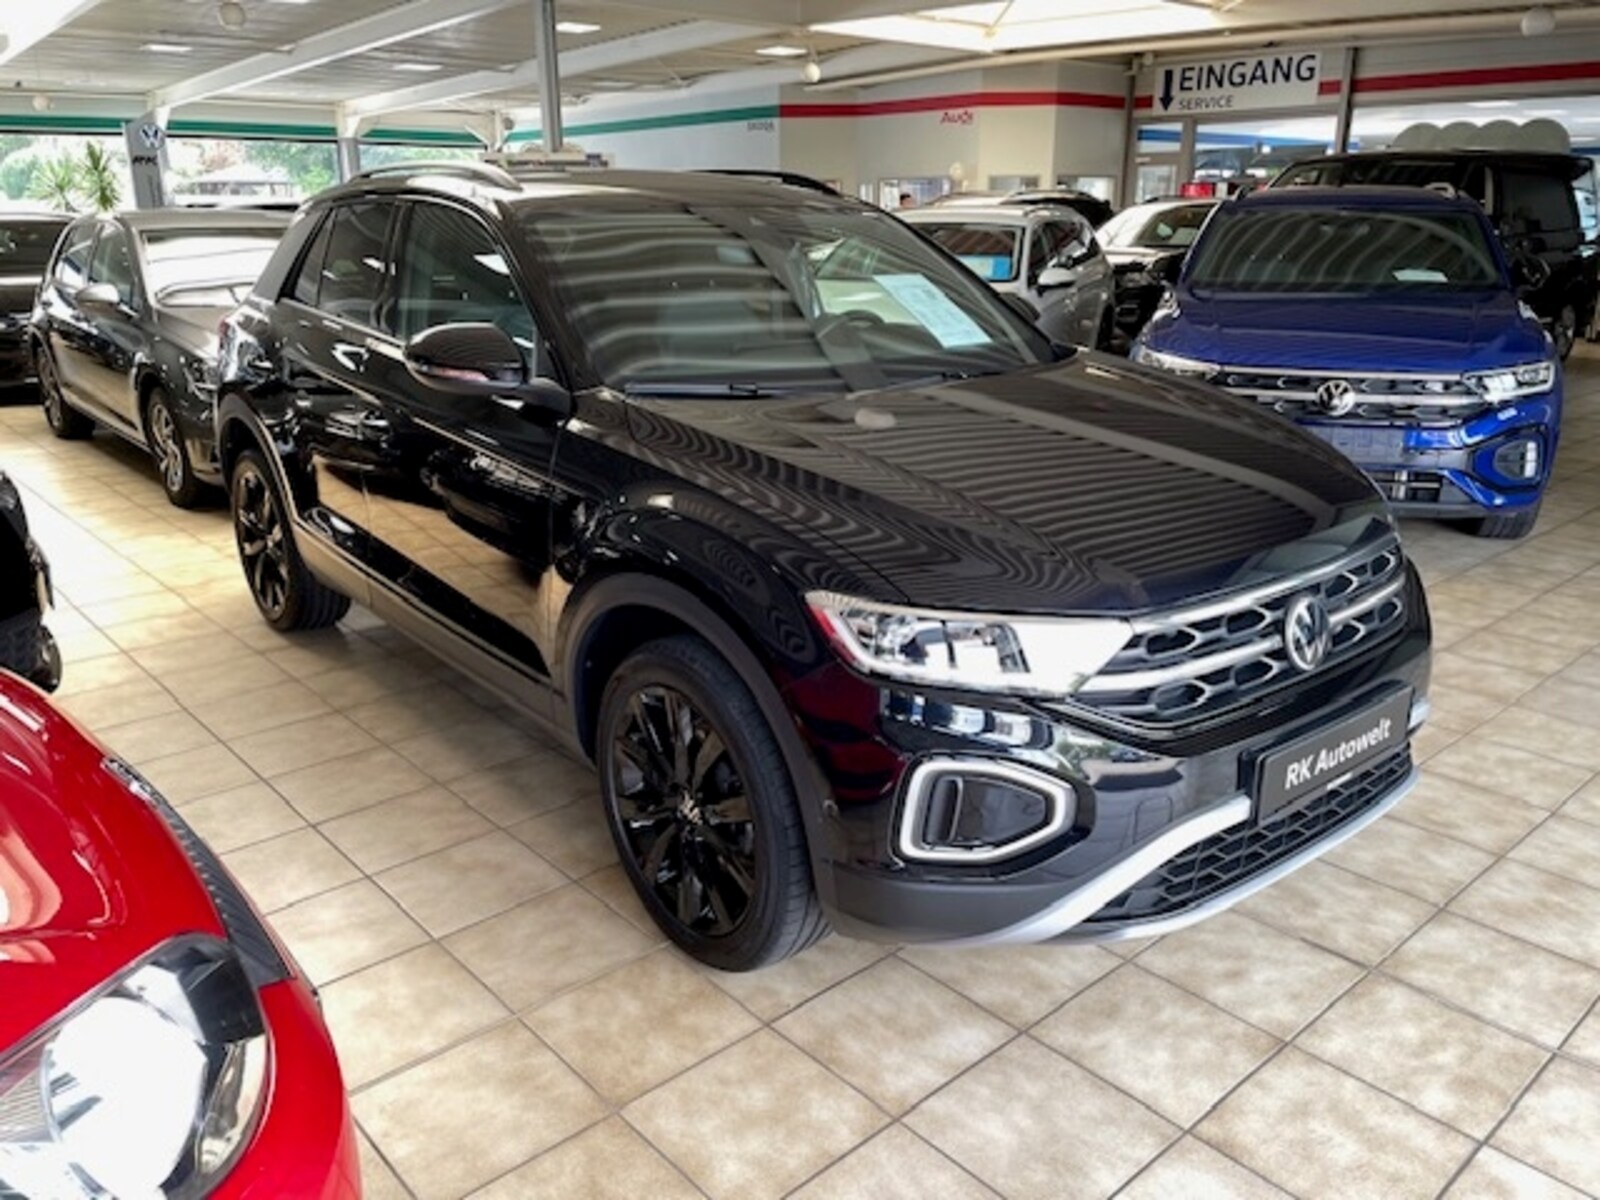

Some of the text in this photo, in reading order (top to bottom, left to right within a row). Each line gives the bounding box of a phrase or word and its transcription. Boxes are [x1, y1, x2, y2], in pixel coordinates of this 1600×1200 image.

[1179, 54, 1317, 91] EINGANG
[1178, 95, 1234, 111] SERVICE
[1284, 754, 1315, 790] RK
[1314, 717, 1392, 776] Autowelt
